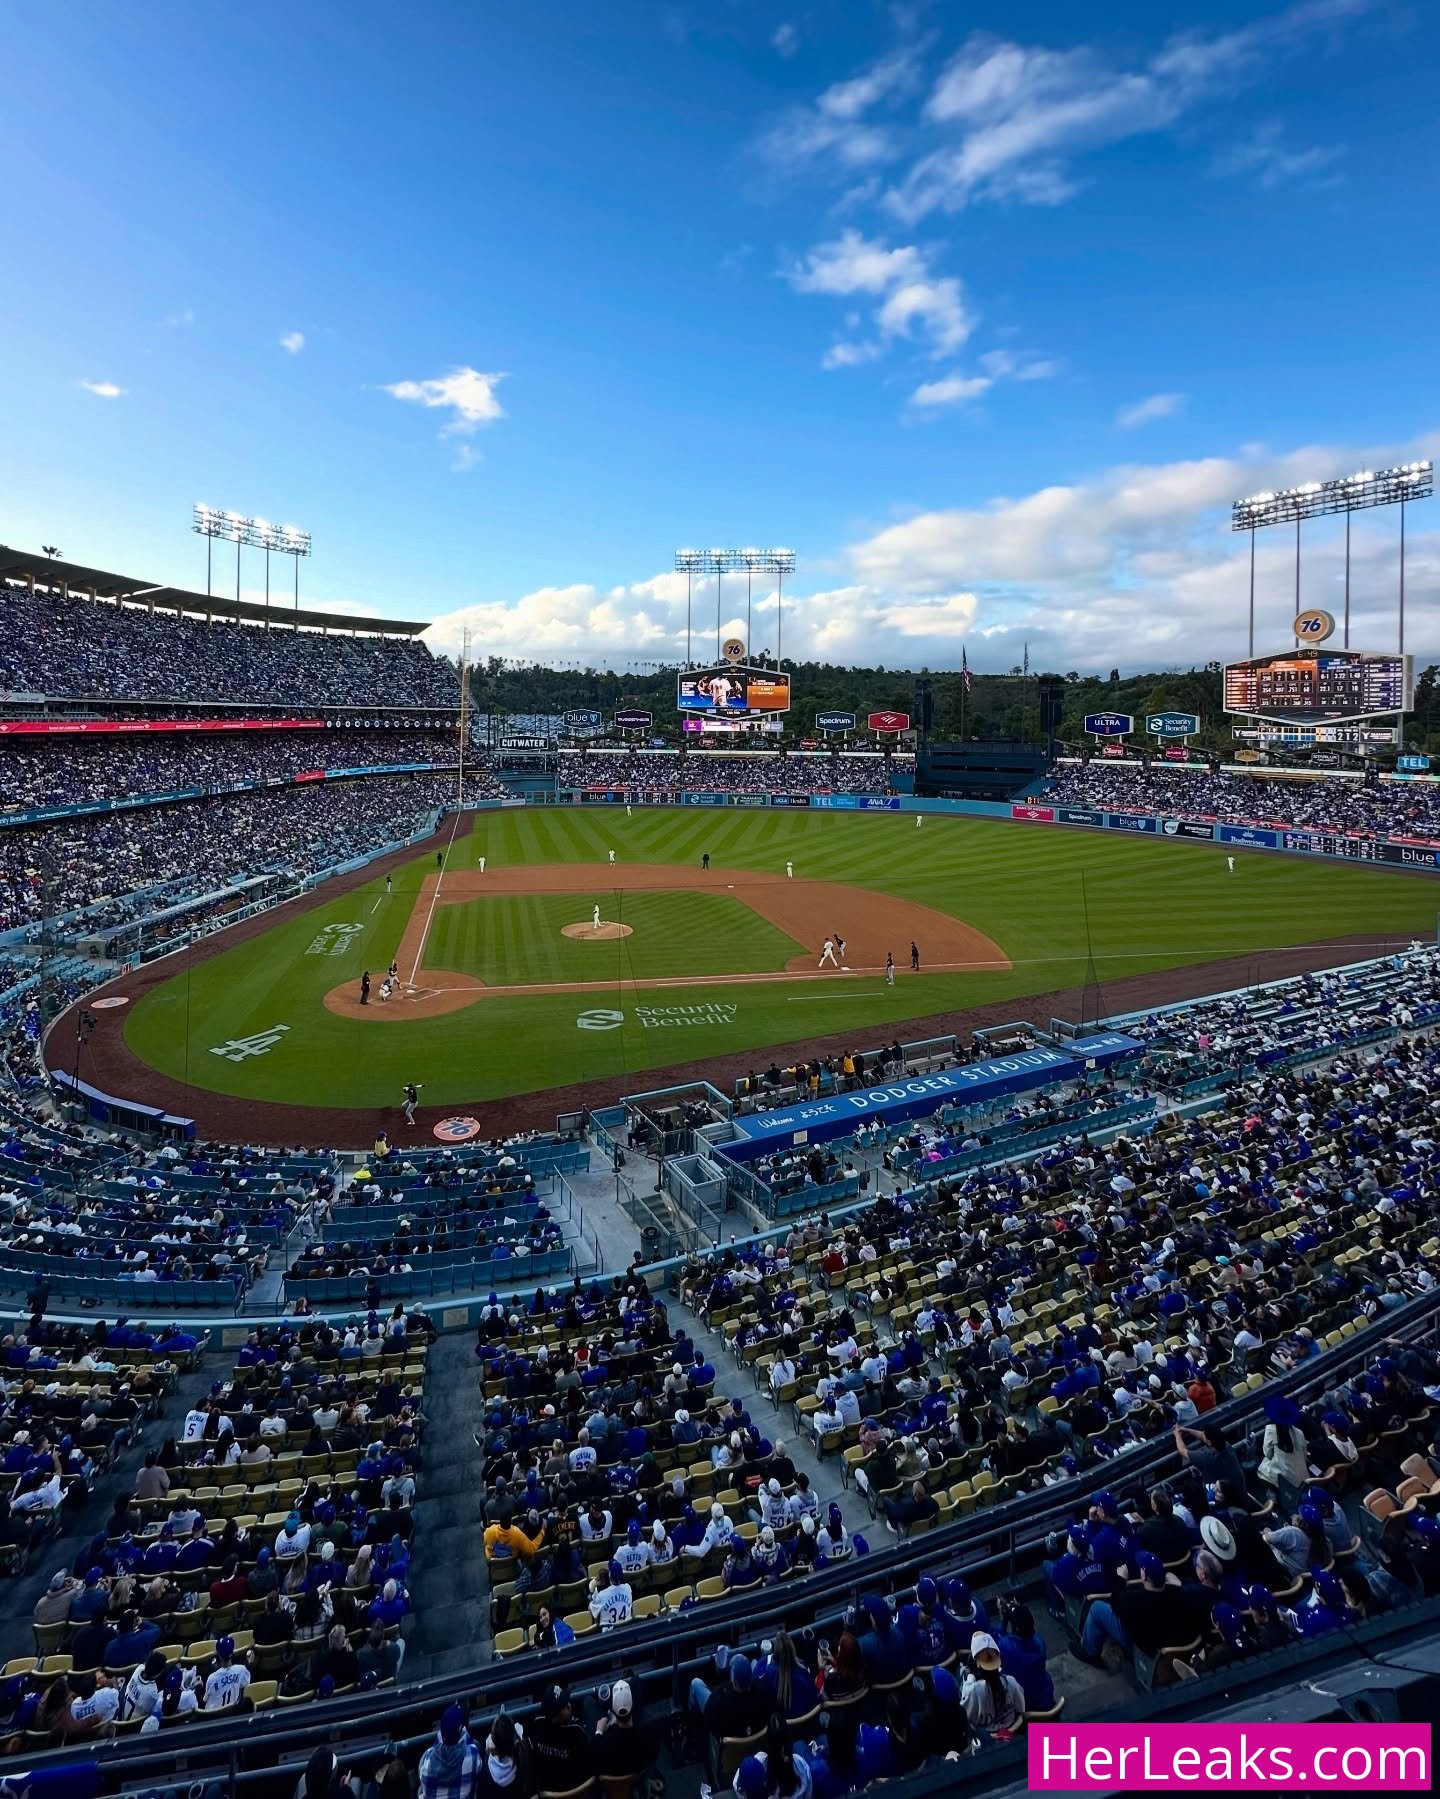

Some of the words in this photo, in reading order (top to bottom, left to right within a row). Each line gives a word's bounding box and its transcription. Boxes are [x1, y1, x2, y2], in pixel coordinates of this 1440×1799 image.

[1301, 618, 1322, 632] 76
[727, 645, 740, 655] 76
[567, 713, 588, 721] blue
[819, 717, 851, 725] Spectrum
[1164, 718, 1192, 726] Security
[502, 738, 545, 748] CUTWATER
[1402, 757, 1425, 767] TEL
[589, 793, 606, 801] blue
[815, 797, 833, 806] TEL
[1119, 817, 1137, 827] blue
[1230, 836, 1266, 846] Budweiser
[1401, 849, 1435, 863] blue
[635, 1003, 737, 1017] Security
[639, 1013, 735, 1028] Benefit
[848, 1075, 958, 1109] DODGER
[960, 1050, 1063, 1081] STADIUM
[440, 1121, 474, 1136] 76
[187, 1423, 196, 1437] 5
[769, 1516, 785, 1529] 50
[608, 1605, 627, 1623] 34
[222, 1691, 232, 1707] 11
